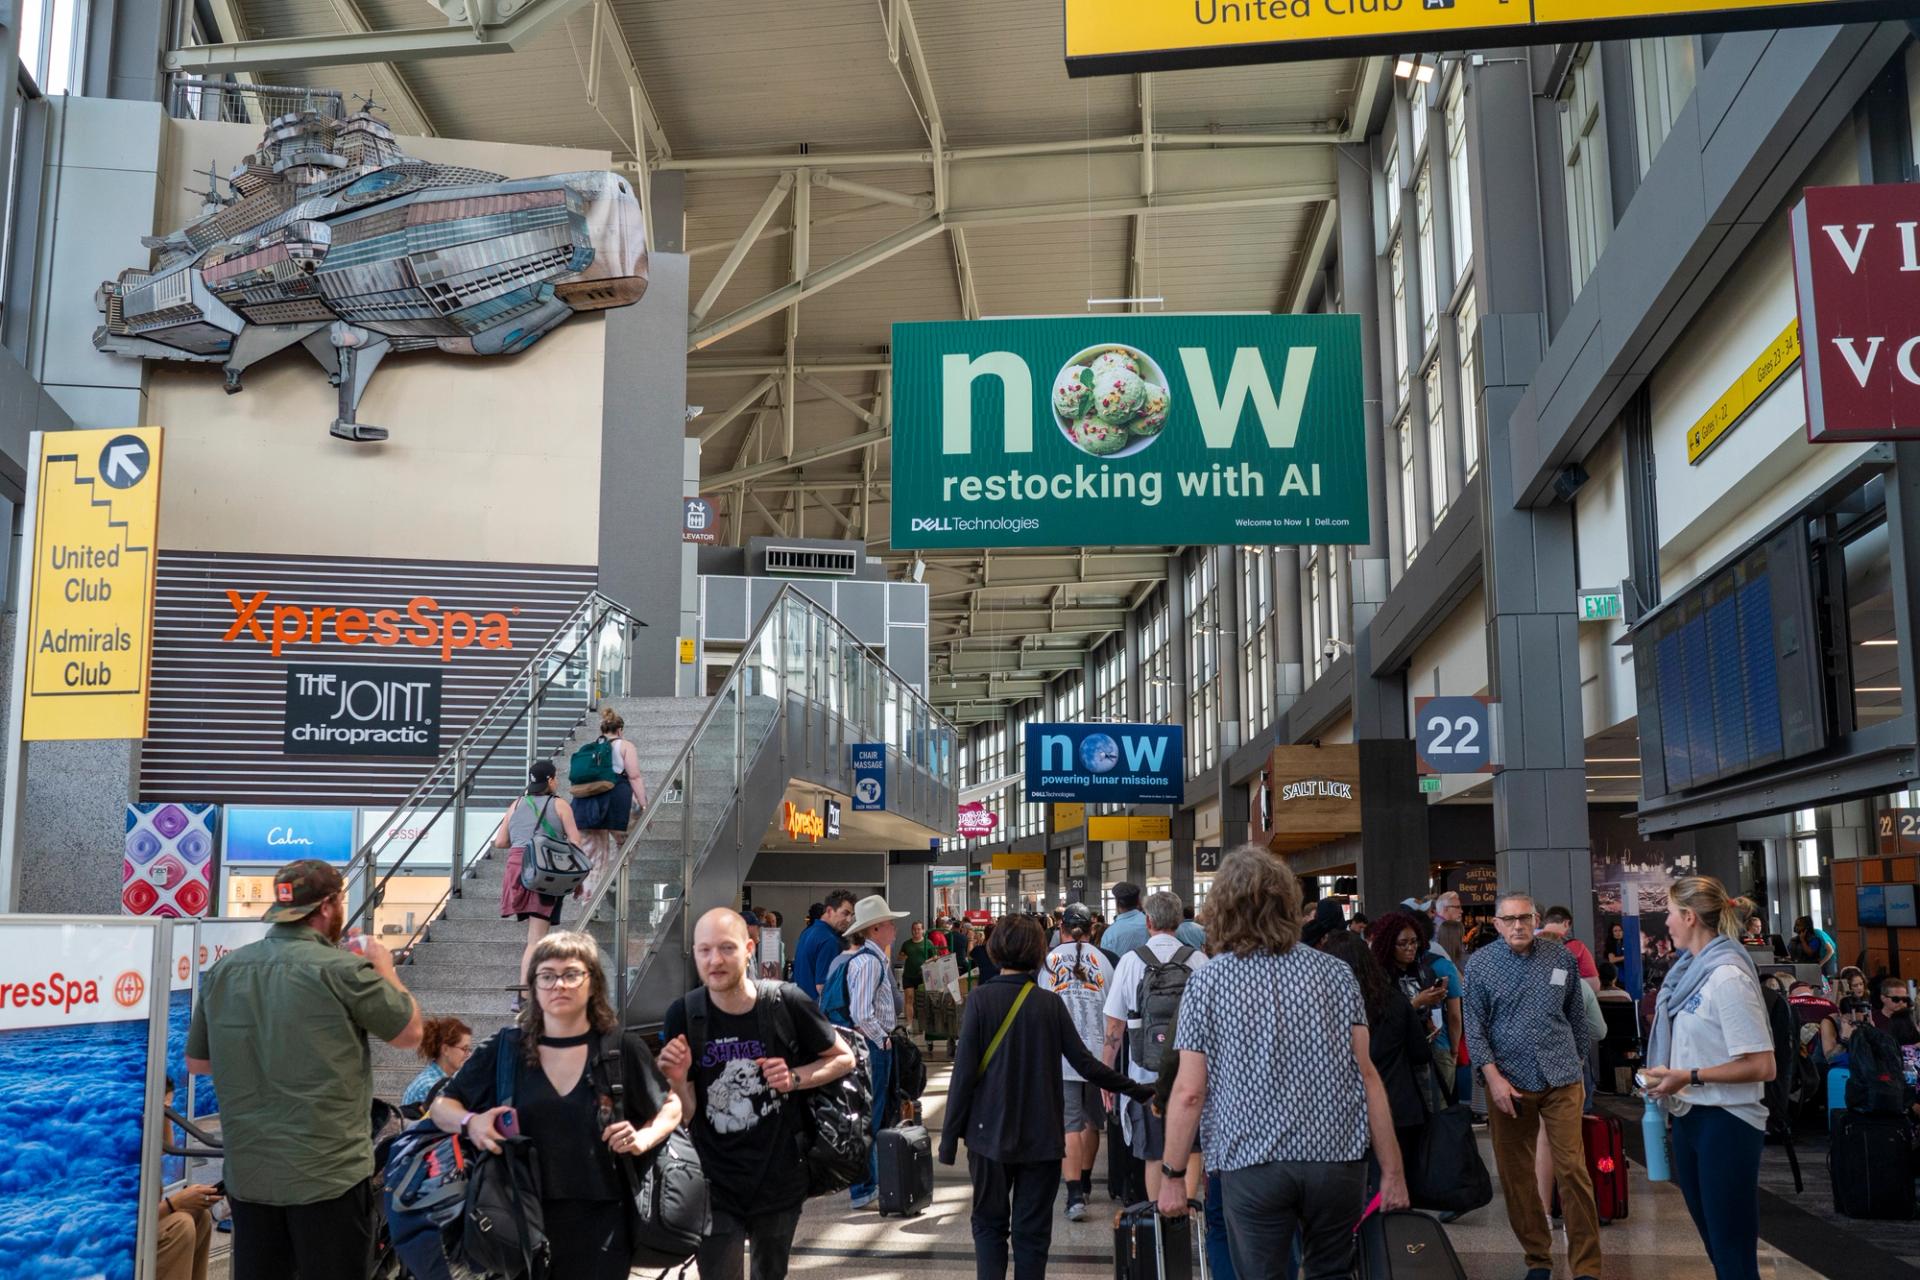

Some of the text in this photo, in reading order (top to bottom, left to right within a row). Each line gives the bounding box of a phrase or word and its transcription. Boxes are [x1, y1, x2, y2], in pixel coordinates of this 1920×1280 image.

[1195, 0, 1309, 24] United
[943, 463, 1321, 506] restocking with AI
[952, 516, 1039, 532] Technologies
[1235, 518, 1272, 526] Welcome
[1284, 518, 1301, 526] Now
[1315, 518, 1349, 526] Dell.com
[51, 544, 120, 570] United
[64, 577, 112, 602] Club
[1585, 596, 1616, 618] EXIT
[222, 588, 513, 662] XpresSpa
[40, 627, 131, 653] Admirals
[64, 661, 111, 686] Club
[295, 673, 337, 696] THE
[330, 681, 431, 721] JOINT
[291, 724, 428, 744] chiropractic
[1427, 715, 1480, 754] 22
[853, 760, 883, 769] MASSAGE
[859, 751, 878, 760] CHAIR
[1041, 774, 1169, 786] powering lunar missions
[1282, 780, 1352, 800] SALT LICK
[786, 801, 824, 843] XpresSpa
[1880, 814, 1920, 836] 22 2
[267, 827, 314, 846] Calm
[1200, 853, 1216, 866] 21
[1072, 880, 1083, 889] 20
[1459, 883, 1477, 891] Beer
[1471, 893, 1494, 901] To Go
